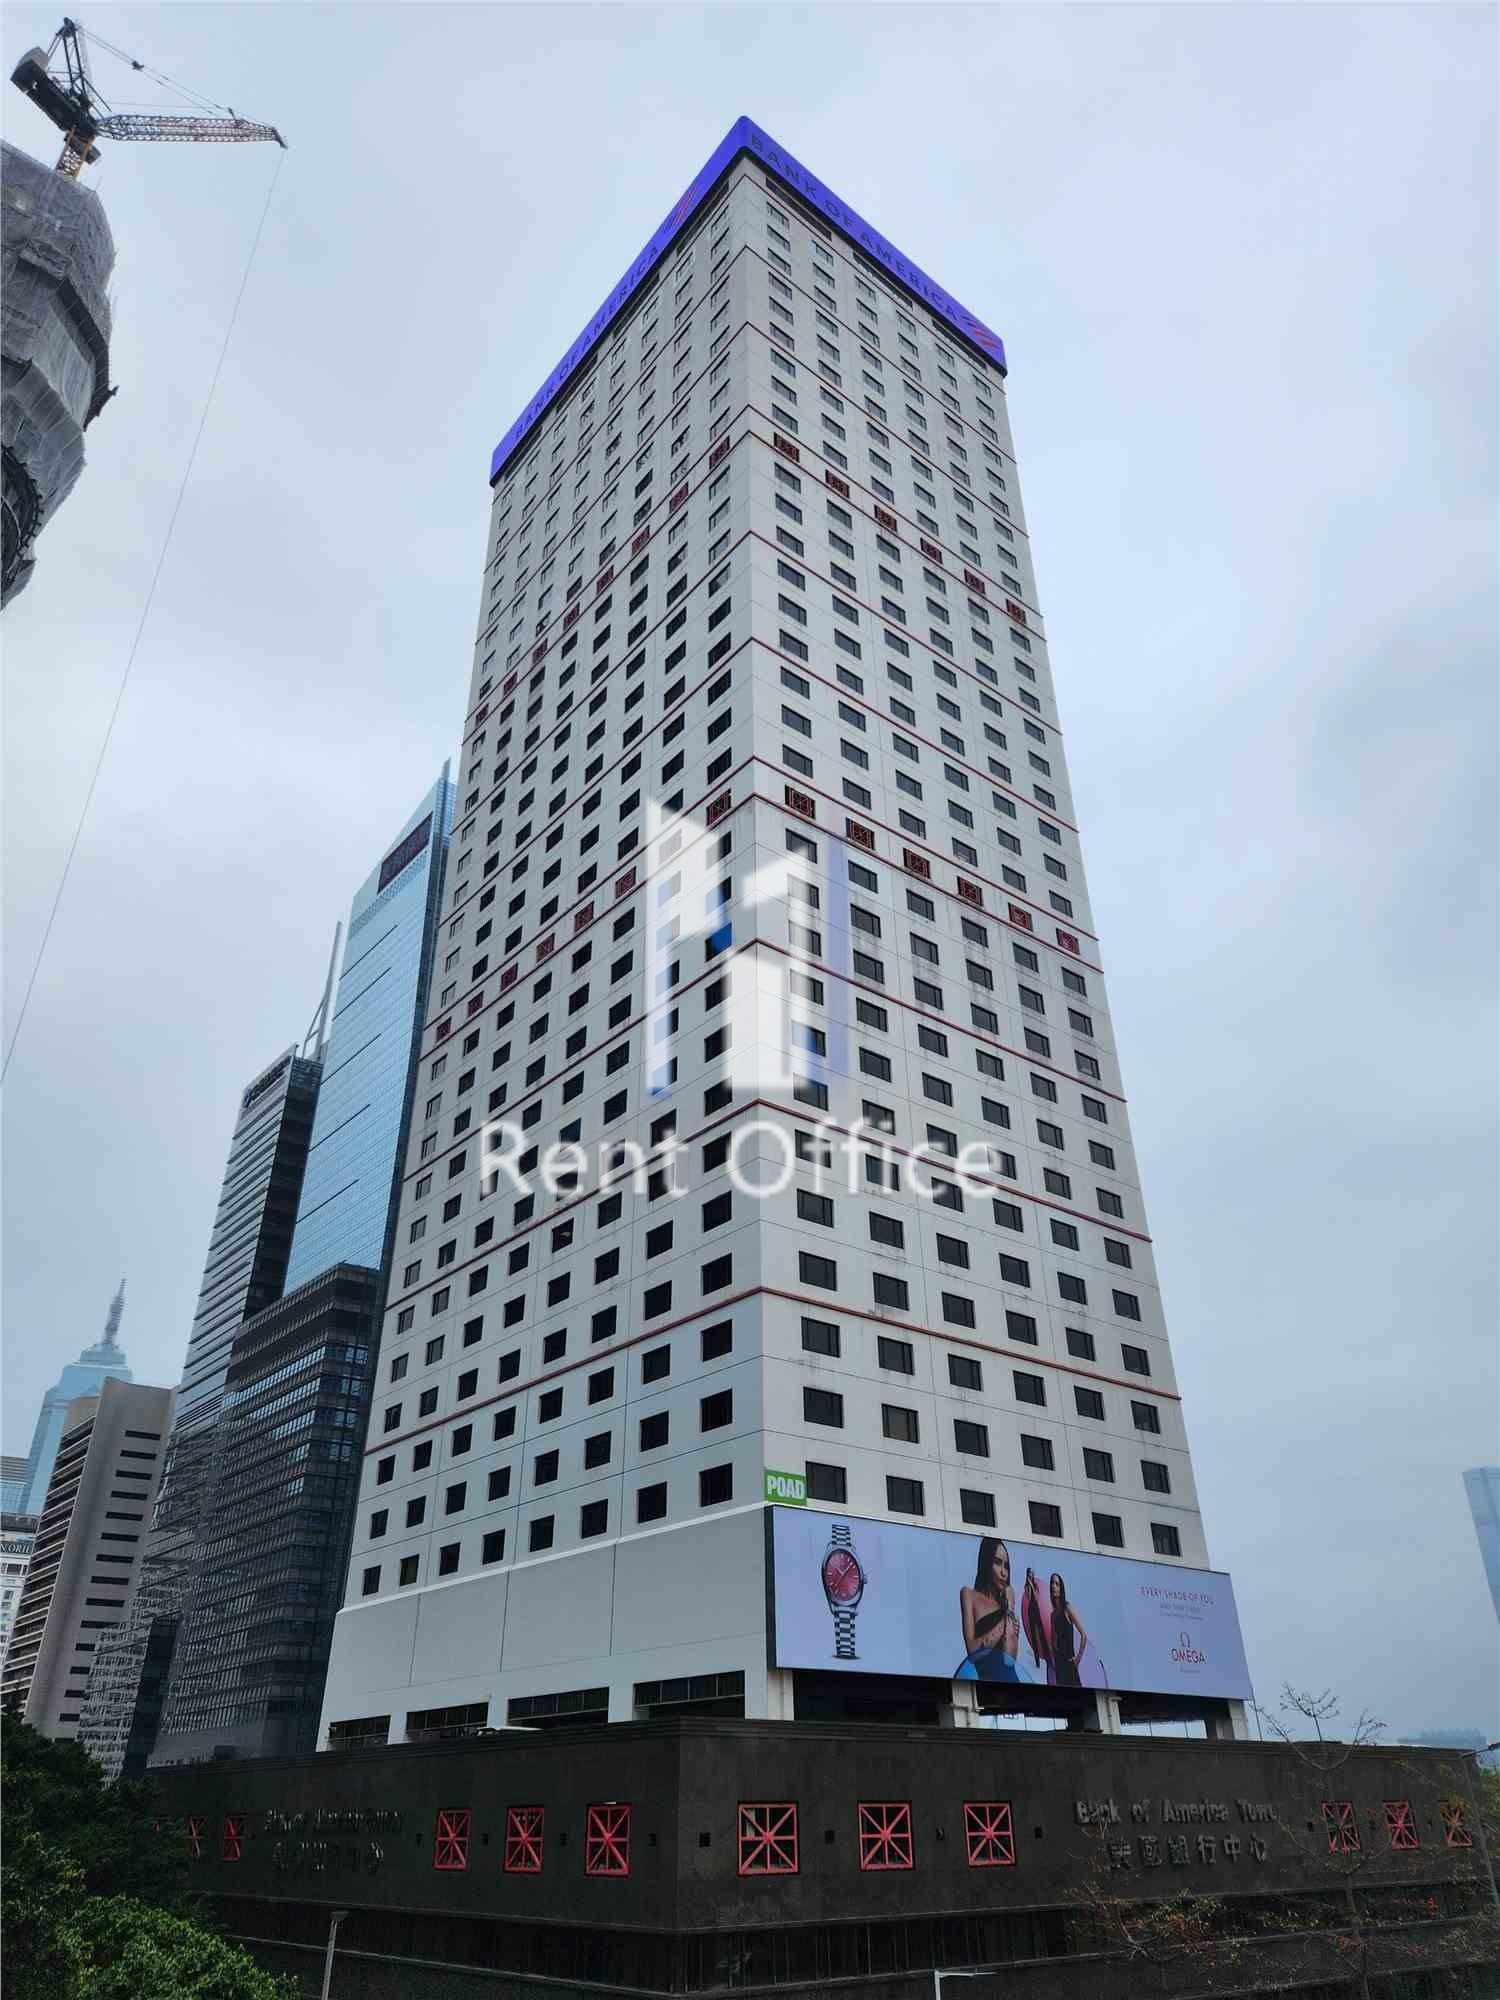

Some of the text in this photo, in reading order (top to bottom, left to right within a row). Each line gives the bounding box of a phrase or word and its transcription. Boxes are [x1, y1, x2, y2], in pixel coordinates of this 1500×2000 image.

[860, 232, 959, 321] AMERICA
[767, 1475, 805, 1499] POAD
[1171, 1648, 1207, 1664] OMEGA
[1162, 1799, 1229, 1822] America
